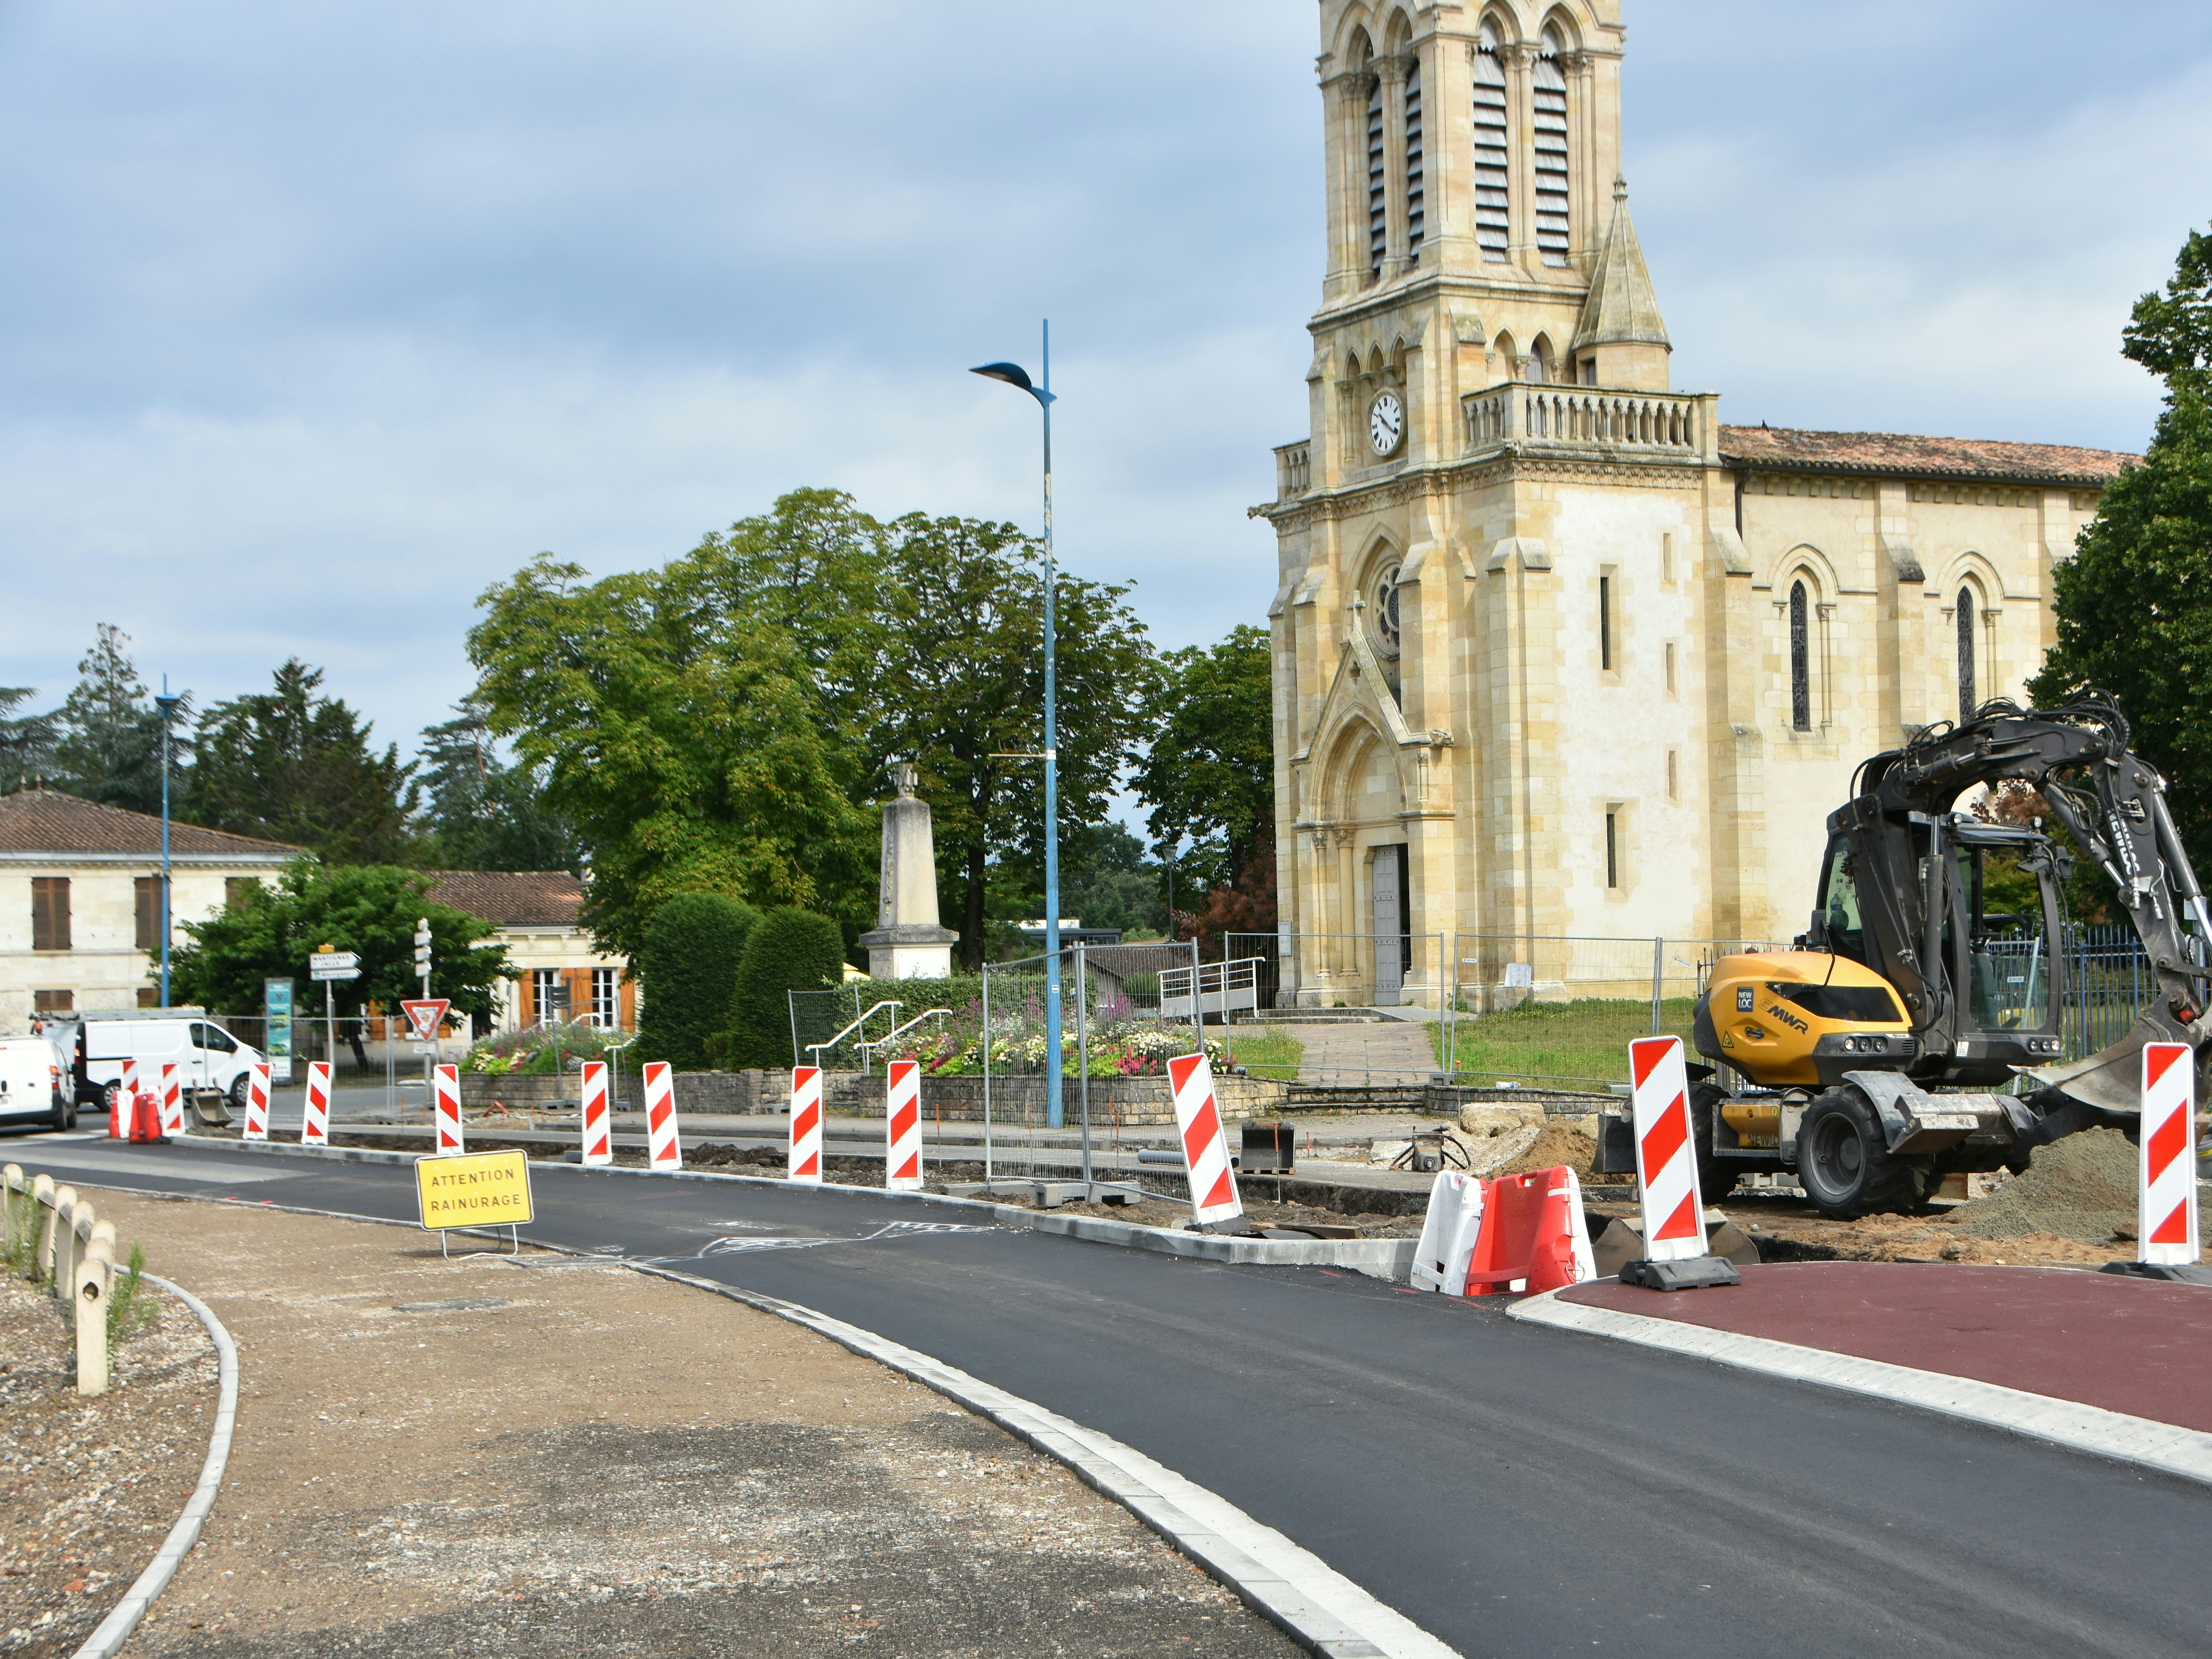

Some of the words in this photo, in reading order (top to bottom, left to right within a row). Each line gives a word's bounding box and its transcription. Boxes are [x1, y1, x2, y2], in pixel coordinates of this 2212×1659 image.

[1738, 999, 1752, 1008] LOC
[1758, 997, 1808, 1036] 9MWR
[431, 1168, 515, 1187] ATTENTION
[431, 1194, 521, 1211] RAINURAGE
